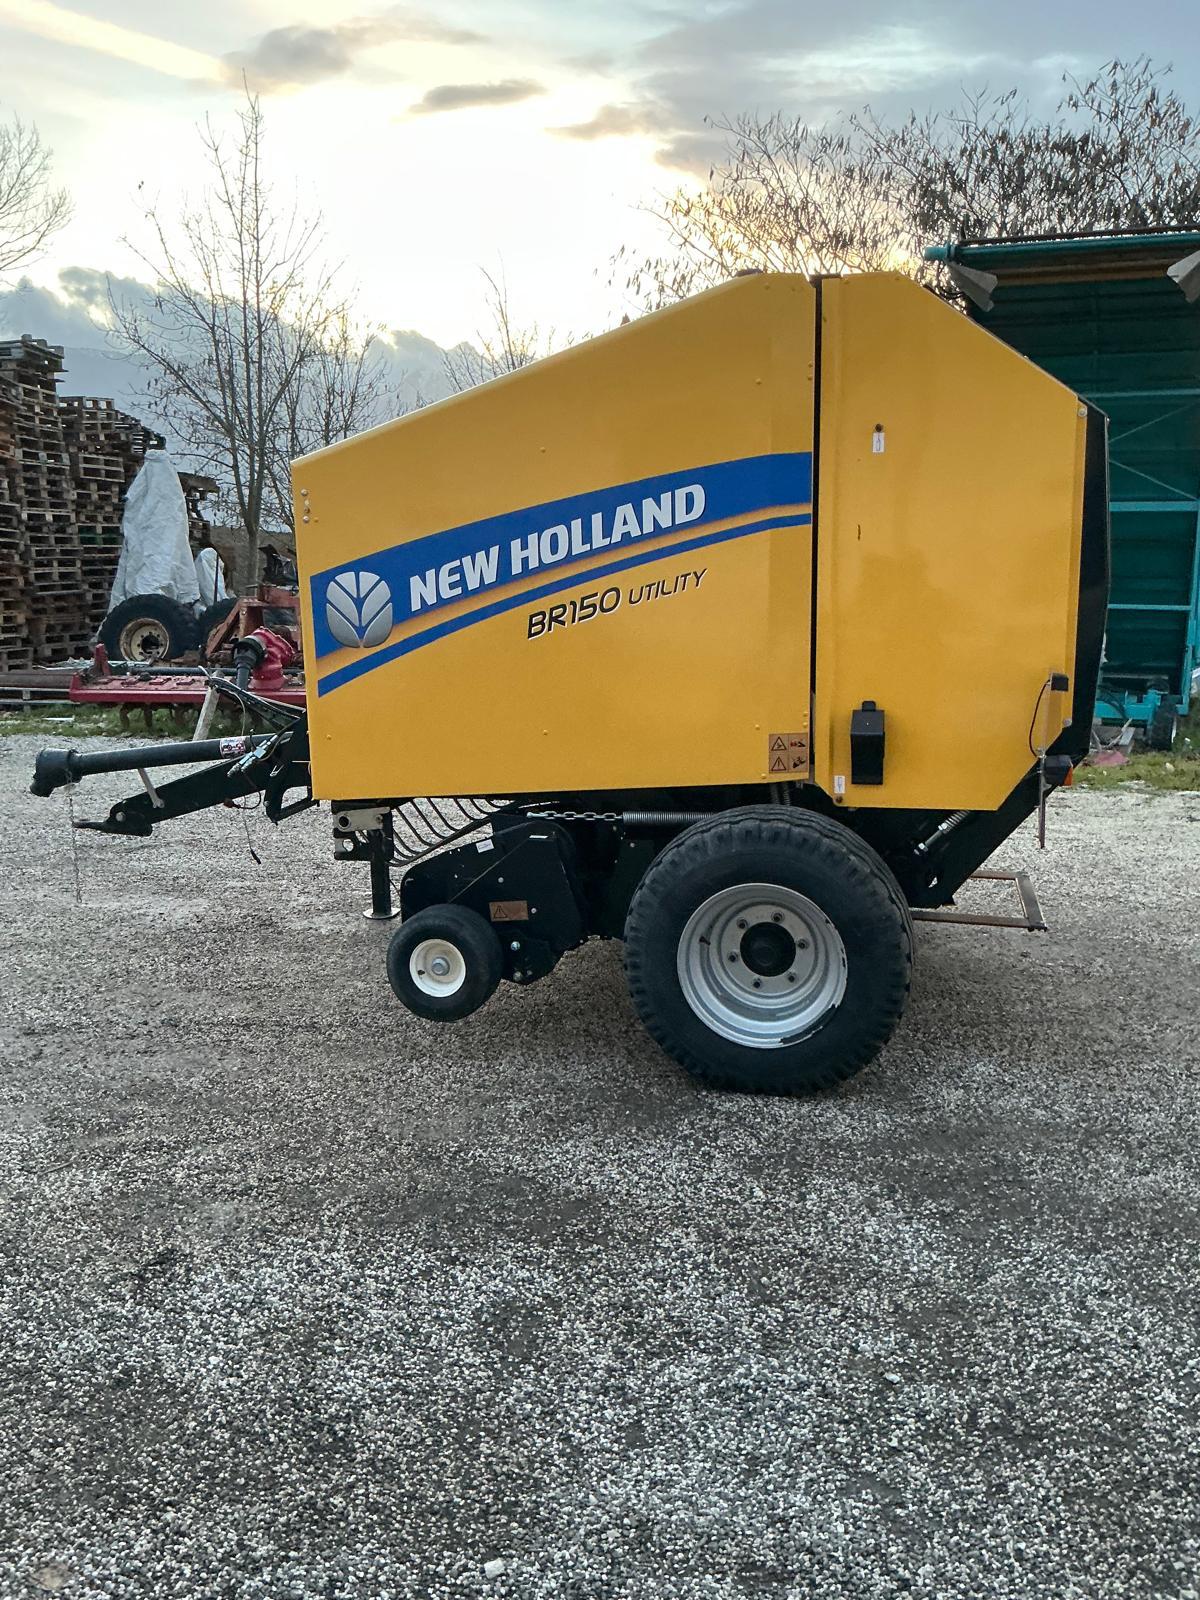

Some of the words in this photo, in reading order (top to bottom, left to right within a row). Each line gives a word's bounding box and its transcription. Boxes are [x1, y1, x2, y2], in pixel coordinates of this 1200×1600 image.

[409, 544, 500, 612] NEW
[510, 483, 706, 576] HOLLAND
[527, 586, 621, 640] BR150
[628, 568, 708, 605] UTILITY
